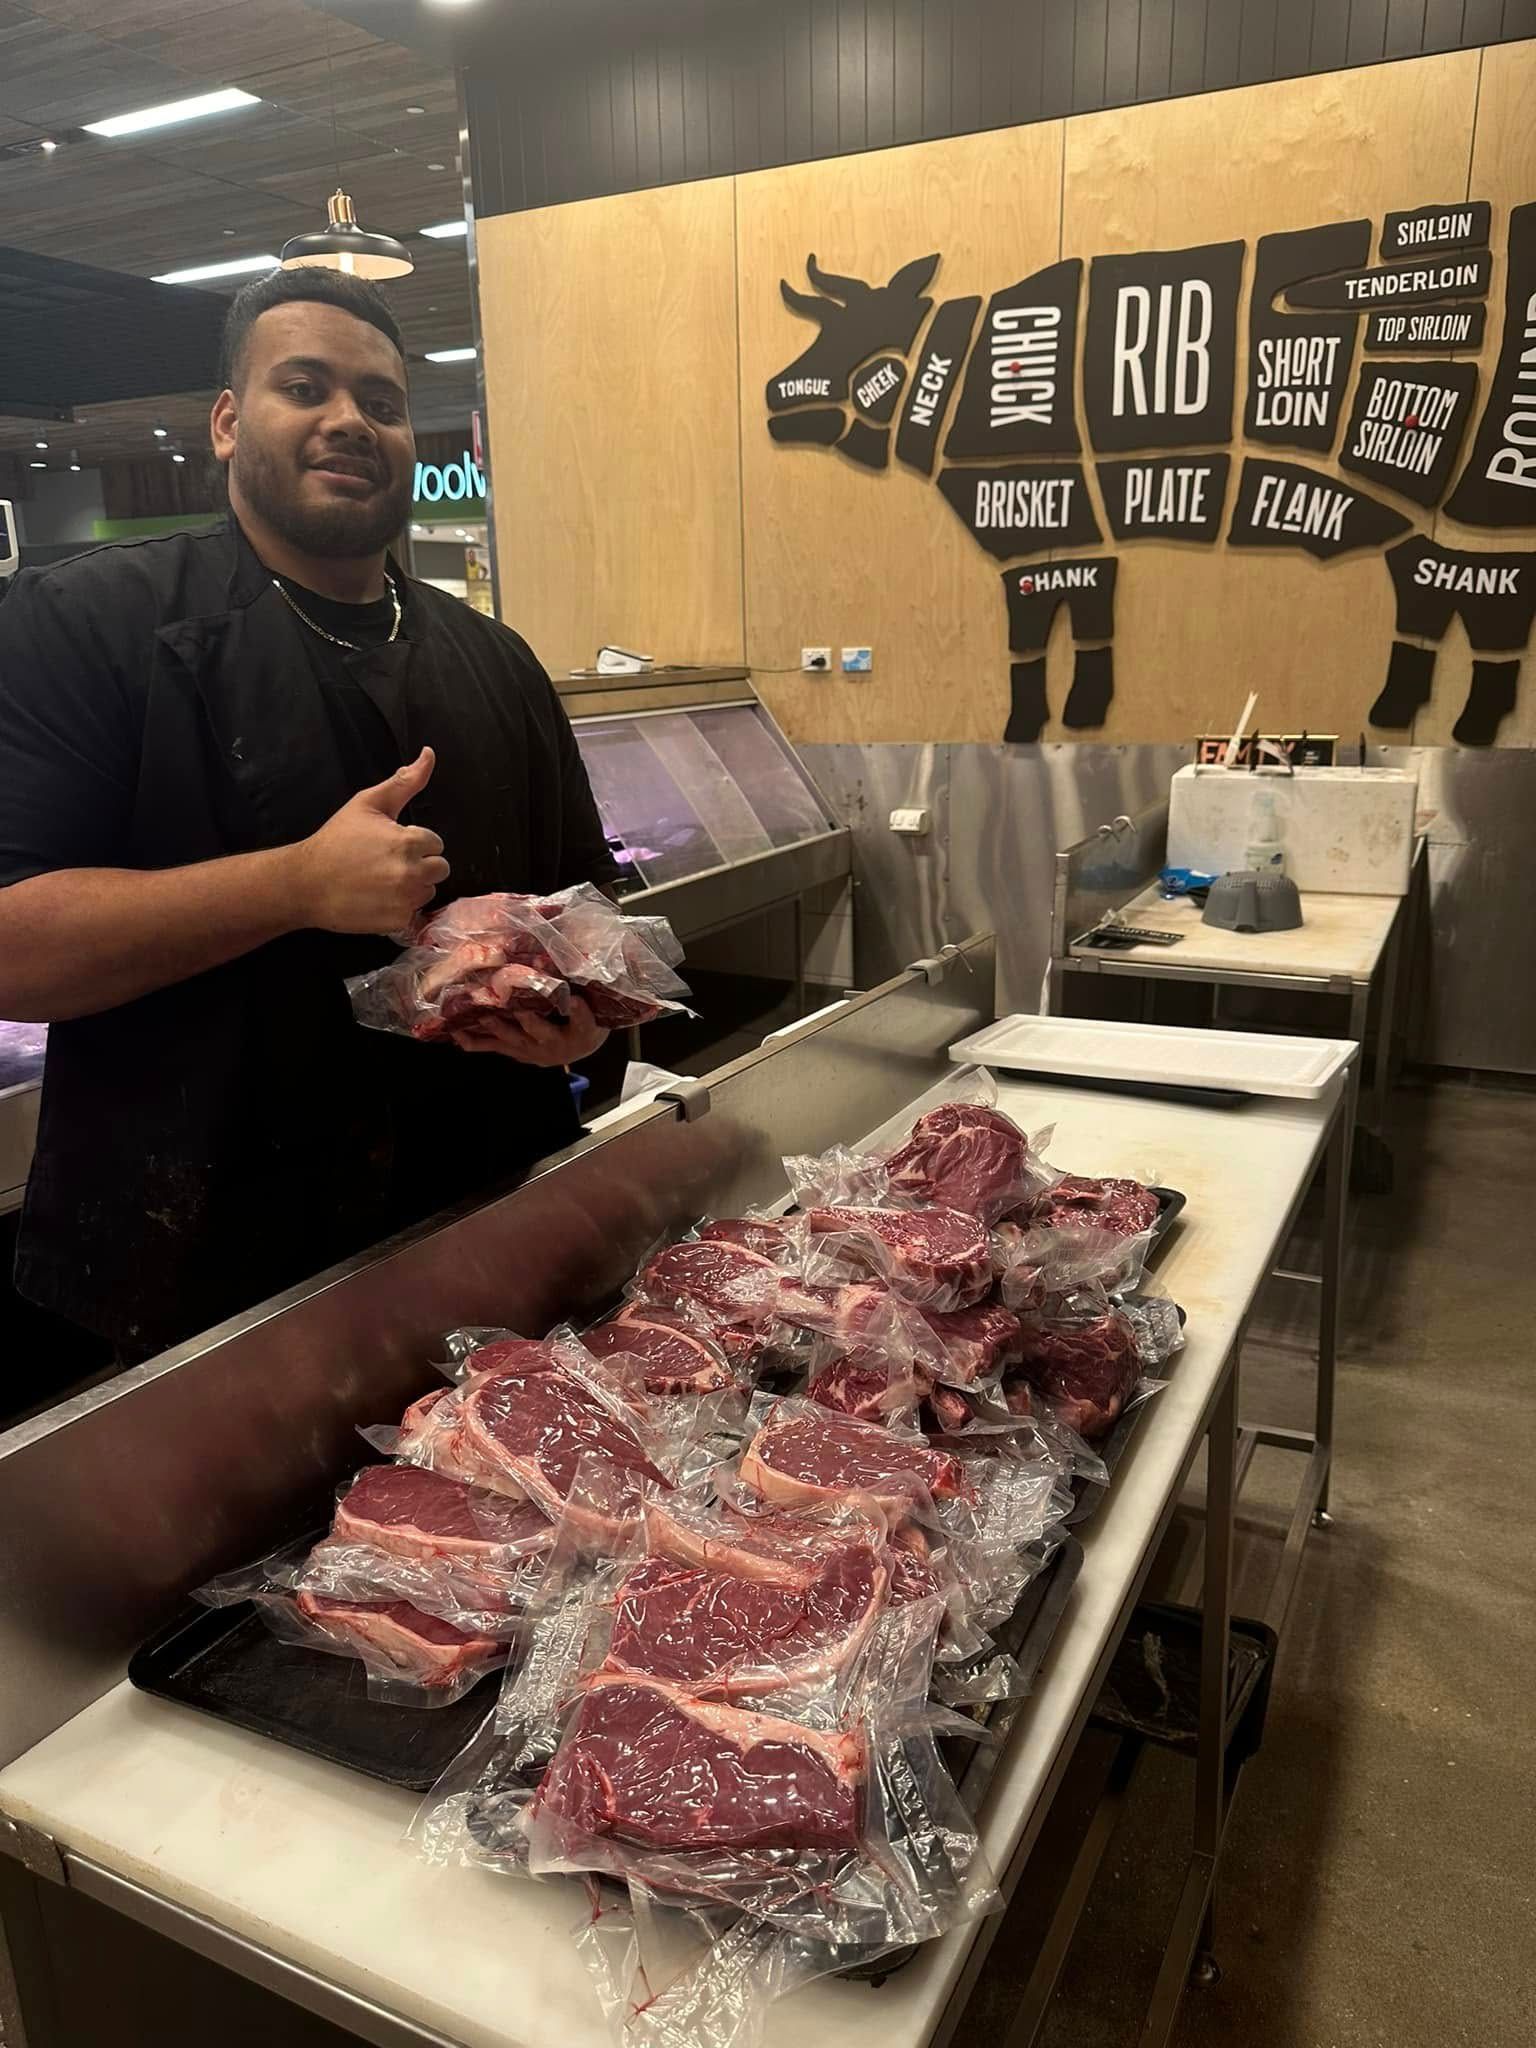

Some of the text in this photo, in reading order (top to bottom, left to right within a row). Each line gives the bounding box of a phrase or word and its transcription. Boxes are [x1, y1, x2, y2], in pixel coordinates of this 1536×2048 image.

[1397, 213, 1473, 246] SIRLOIN
[1345, 264, 1479, 300] TENDERLOIN
[1112, 279, 1214, 418] RIB
[1376, 313, 1472, 343] TOP SIRLOIN
[856, 362, 900, 408] CHEEK
[989, 305, 1062, 428] CHUCK
[1256, 336, 1342, 389] SHORT
[777, 378, 831, 399] TONGUE
[909, 352, 953, 427] NECK
[1255, 390, 1329, 427] LOIN
[1366, 377, 1459, 431] BOTTOM
[1352, 419, 1443, 475] SIRLOIN
[975, 478, 1076, 529] BRISKET
[1124, 467, 1212, 526] PLATE
[1250, 474, 1355, 541] FLANK
[1018, 566, 1099, 596] SHANK
[1413, 558, 1521, 595] SHANK
